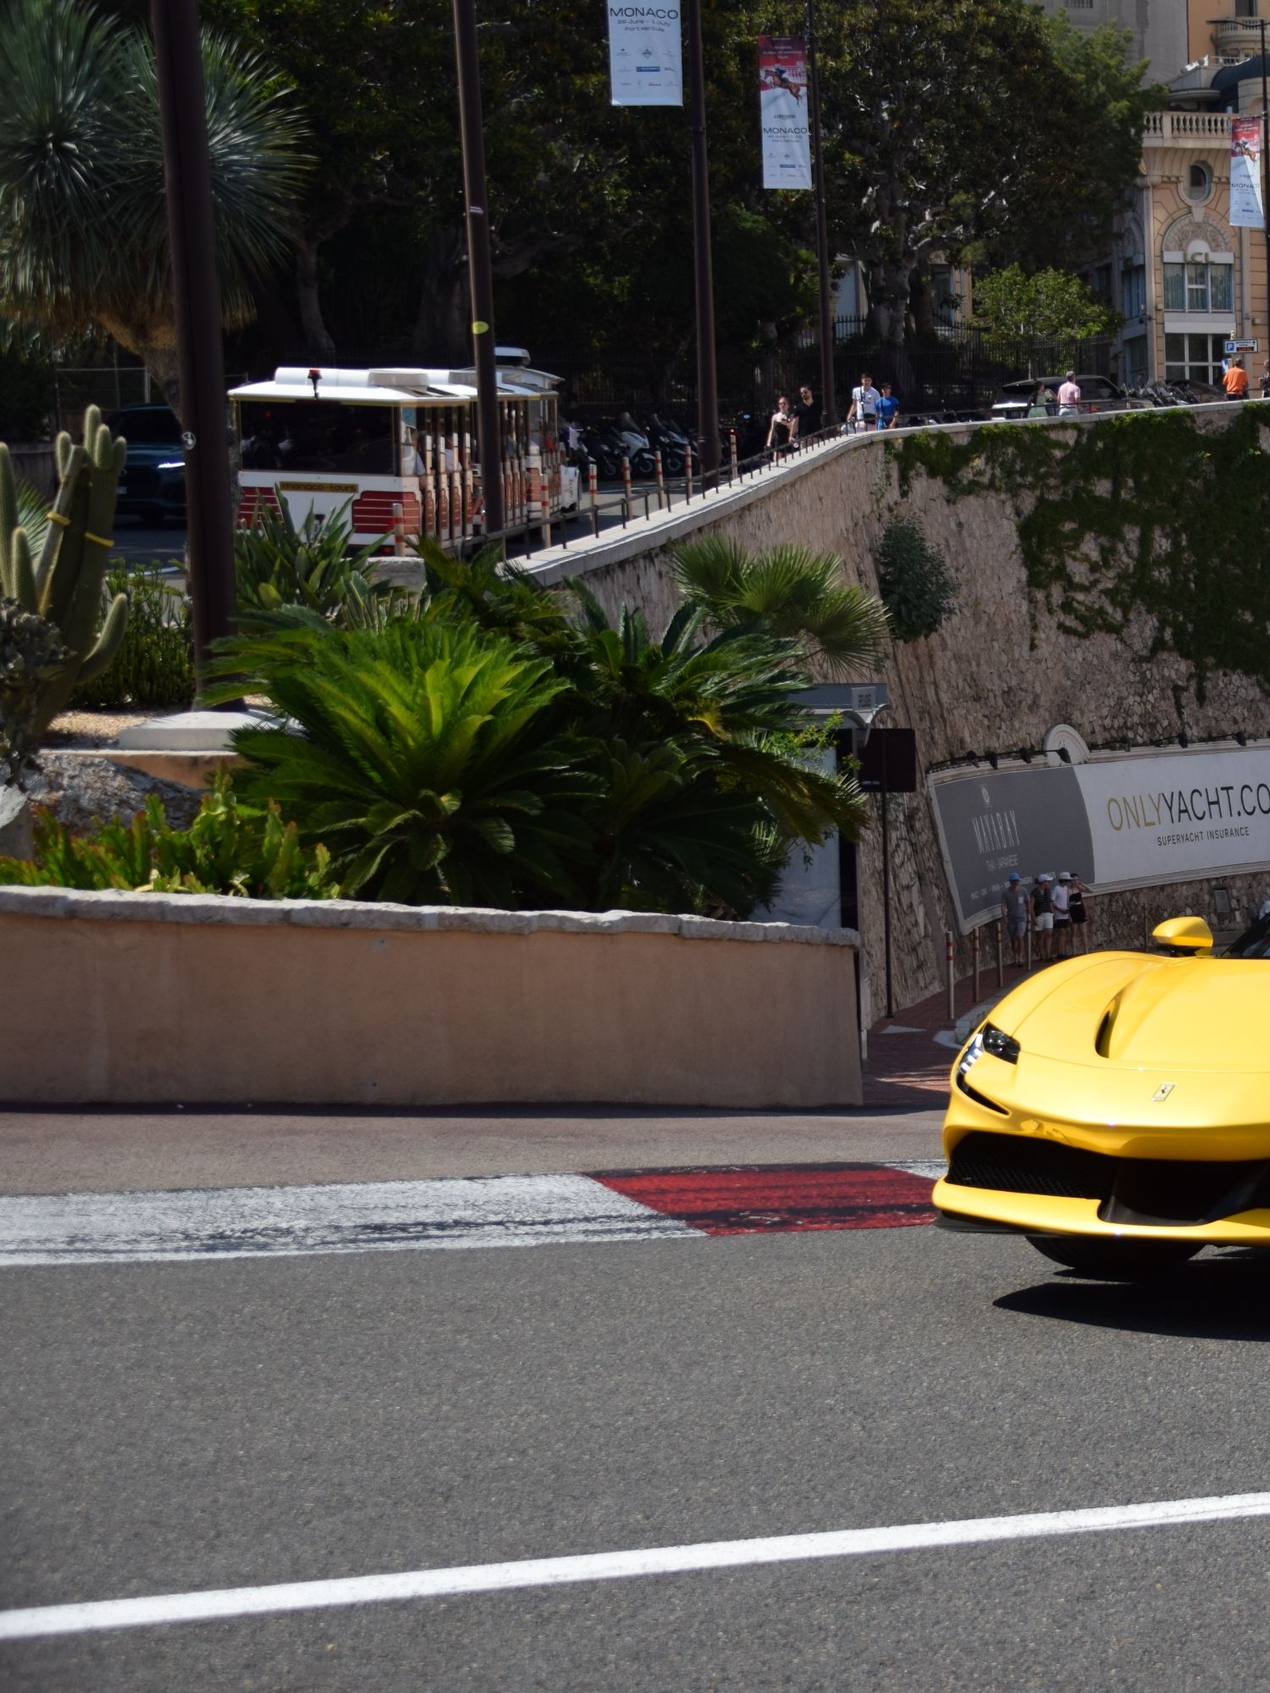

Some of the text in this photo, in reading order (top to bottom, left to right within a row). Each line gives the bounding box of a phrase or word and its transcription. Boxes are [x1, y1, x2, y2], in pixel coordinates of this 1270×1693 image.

[610, 7, 679, 20] MONACO
[763, 127, 808, 135] MONACO
[1184, 251, 1215, 265] LCL
[1157, 826, 1250, 847] SUPERYACHT INSURANCE
